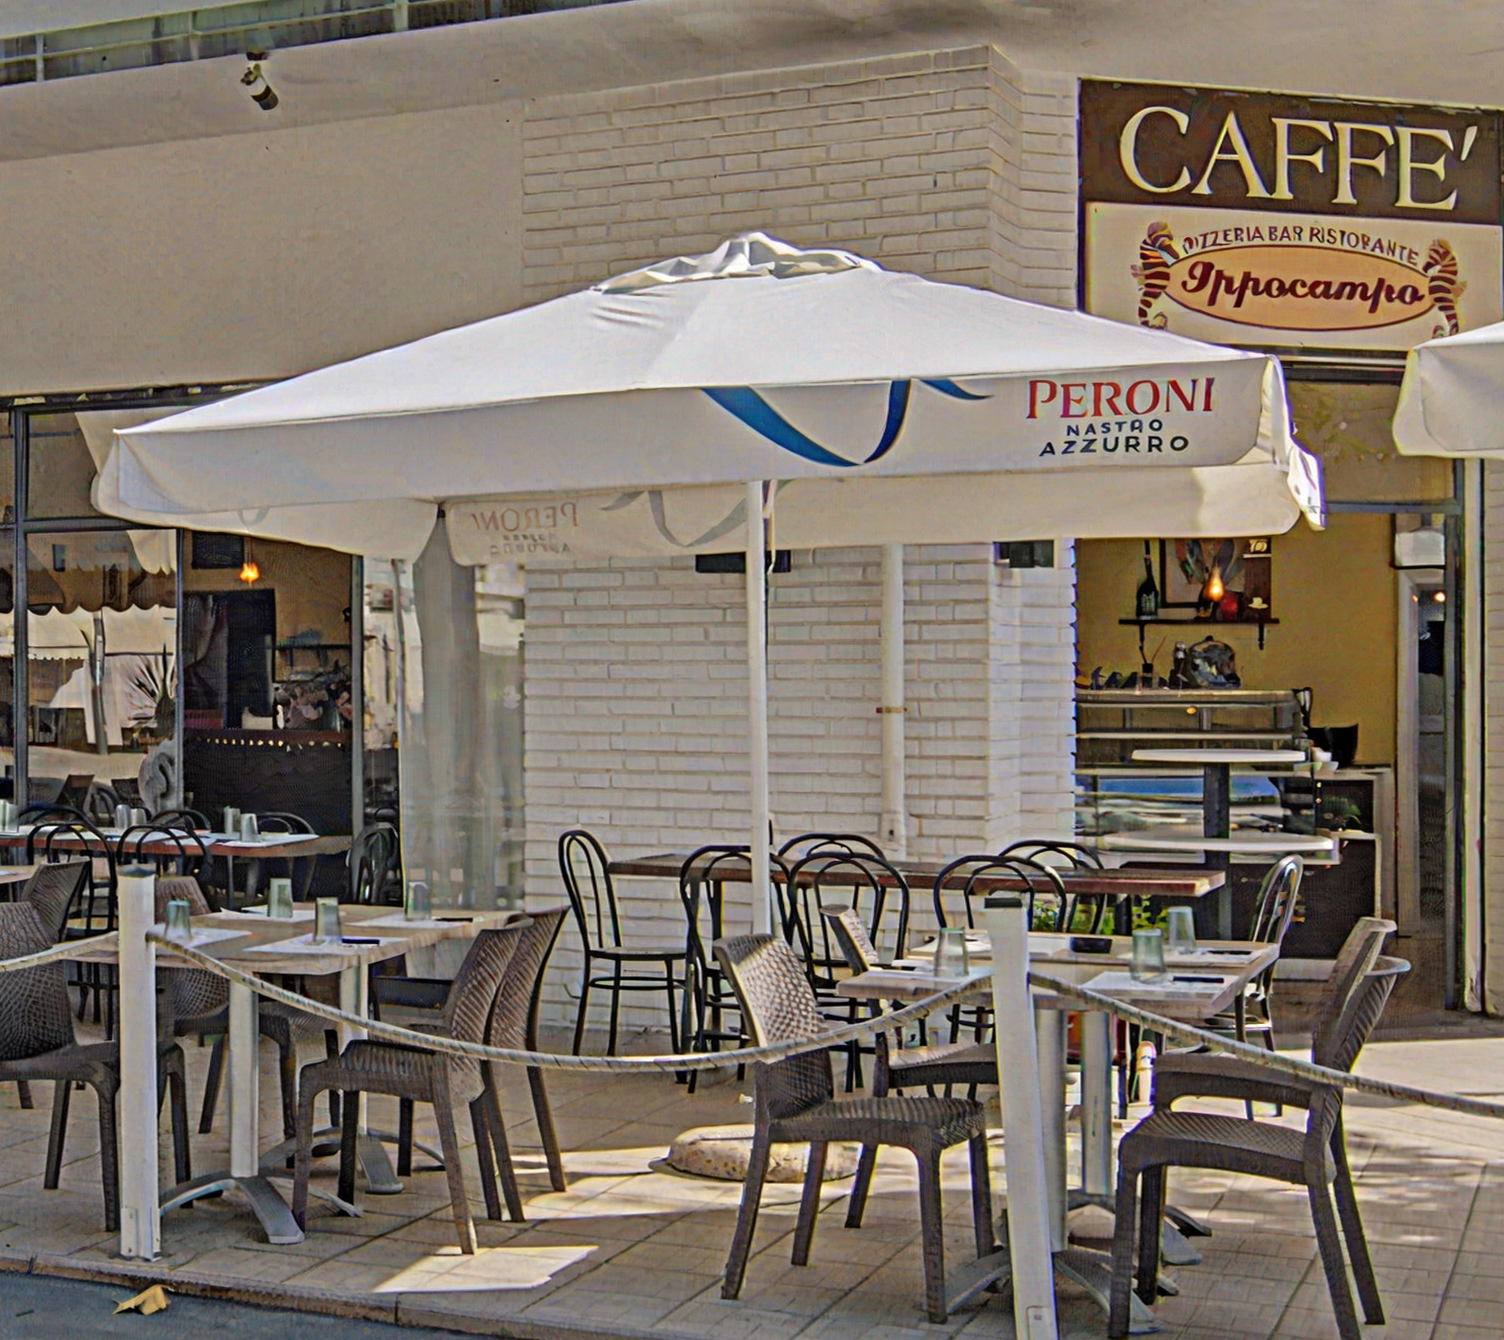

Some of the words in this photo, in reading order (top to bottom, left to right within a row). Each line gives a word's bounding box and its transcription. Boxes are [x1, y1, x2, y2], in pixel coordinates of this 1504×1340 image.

[1119, 106, 1478, 210] CAFFE'
[1182, 225, 1265, 255] PIZZERIA
[1268, 225, 1304, 242] BAR
[1309, 226, 1420, 267] RISTORANTE
[1180, 260, 1426, 315] Ippocampo
[1026, 377, 1215, 419] PERONI
[1039, 435, 1190, 456] AZZURRO
[1066, 418, 1164, 435] NASTRO
